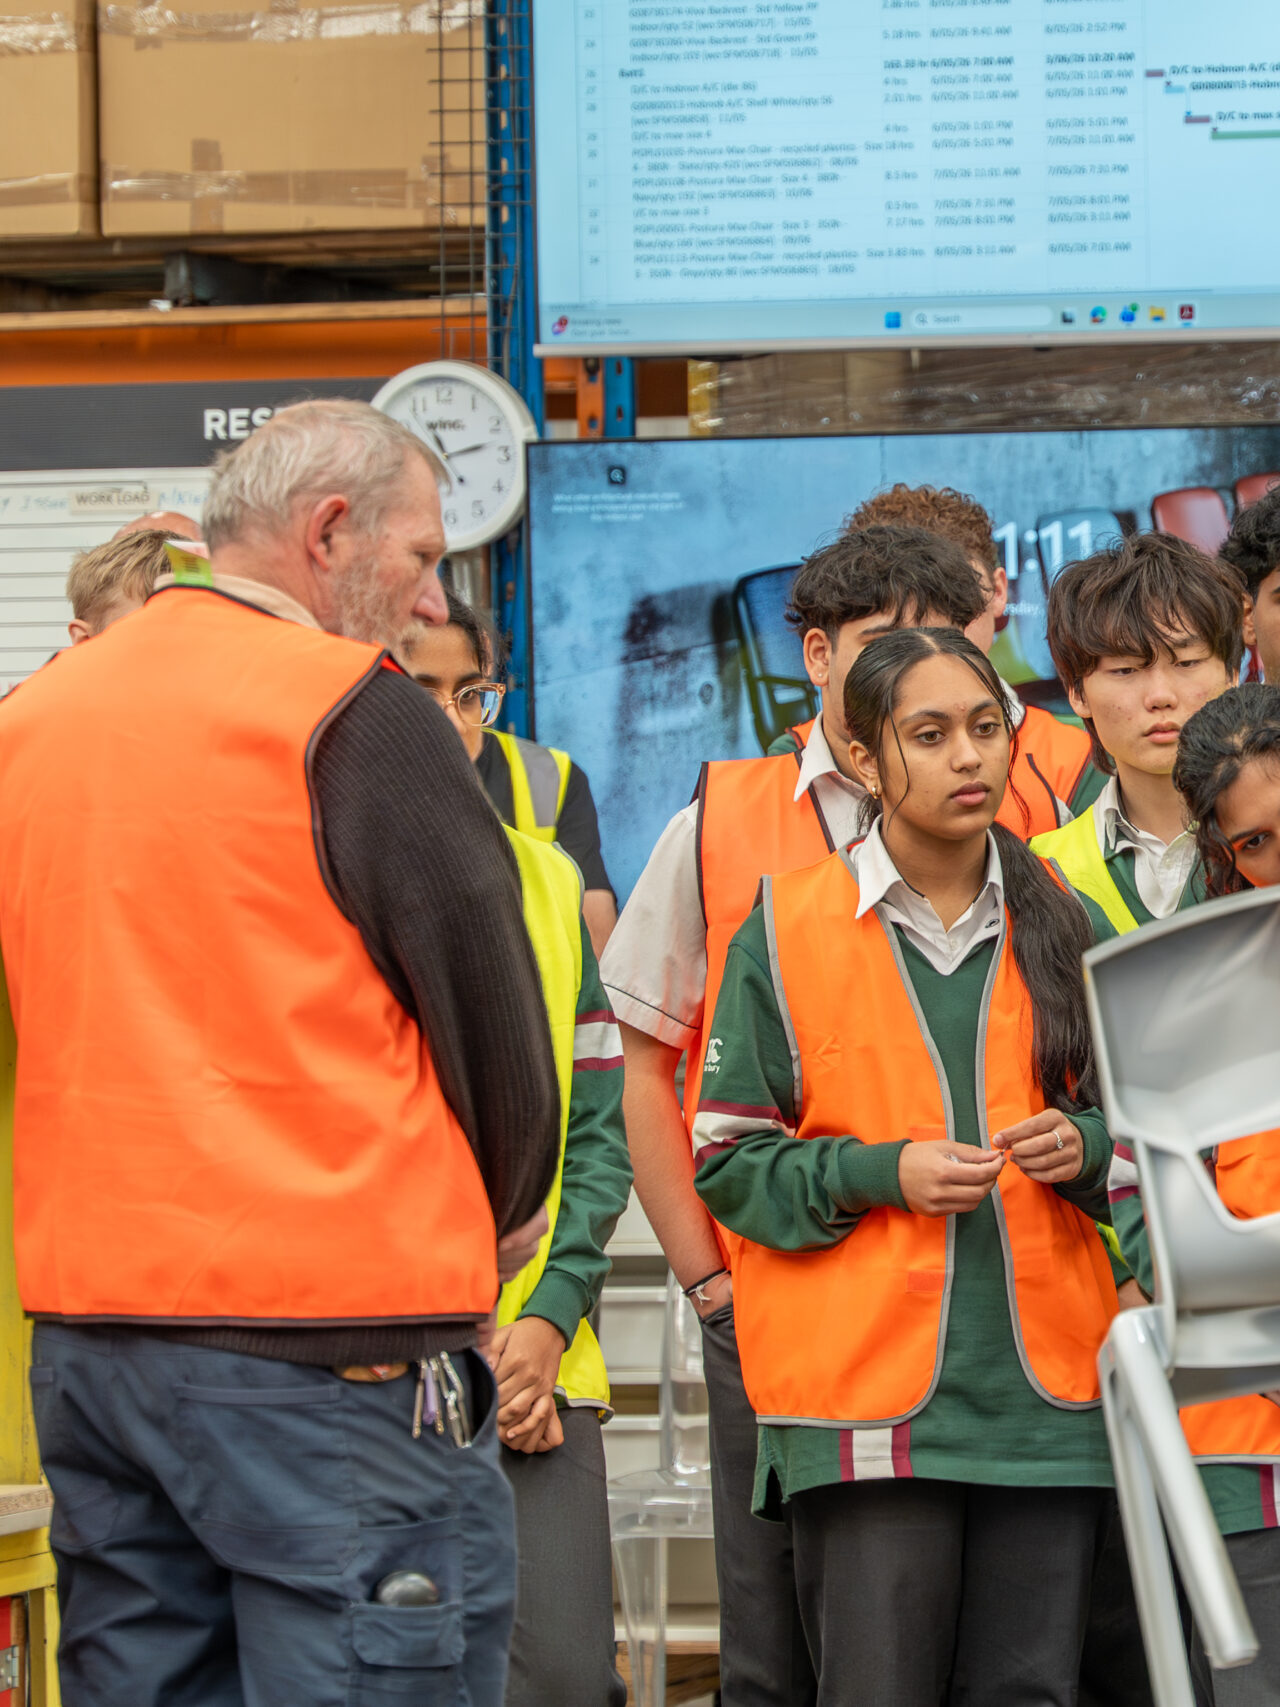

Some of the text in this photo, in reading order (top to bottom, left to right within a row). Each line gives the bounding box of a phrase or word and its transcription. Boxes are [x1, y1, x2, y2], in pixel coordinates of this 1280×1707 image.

[436, 386, 452, 403] 12
[412, 397, 427, 413] 11
[489, 416, 502, 432] 2
[498, 446, 510, 464] 3
[492, 479, 504, 493] 4
[75, 491, 113, 505] WORK
[117, 490, 150, 504] LOAD
[444, 509, 456, 525] 6
[472, 500, 484, 518] 5
